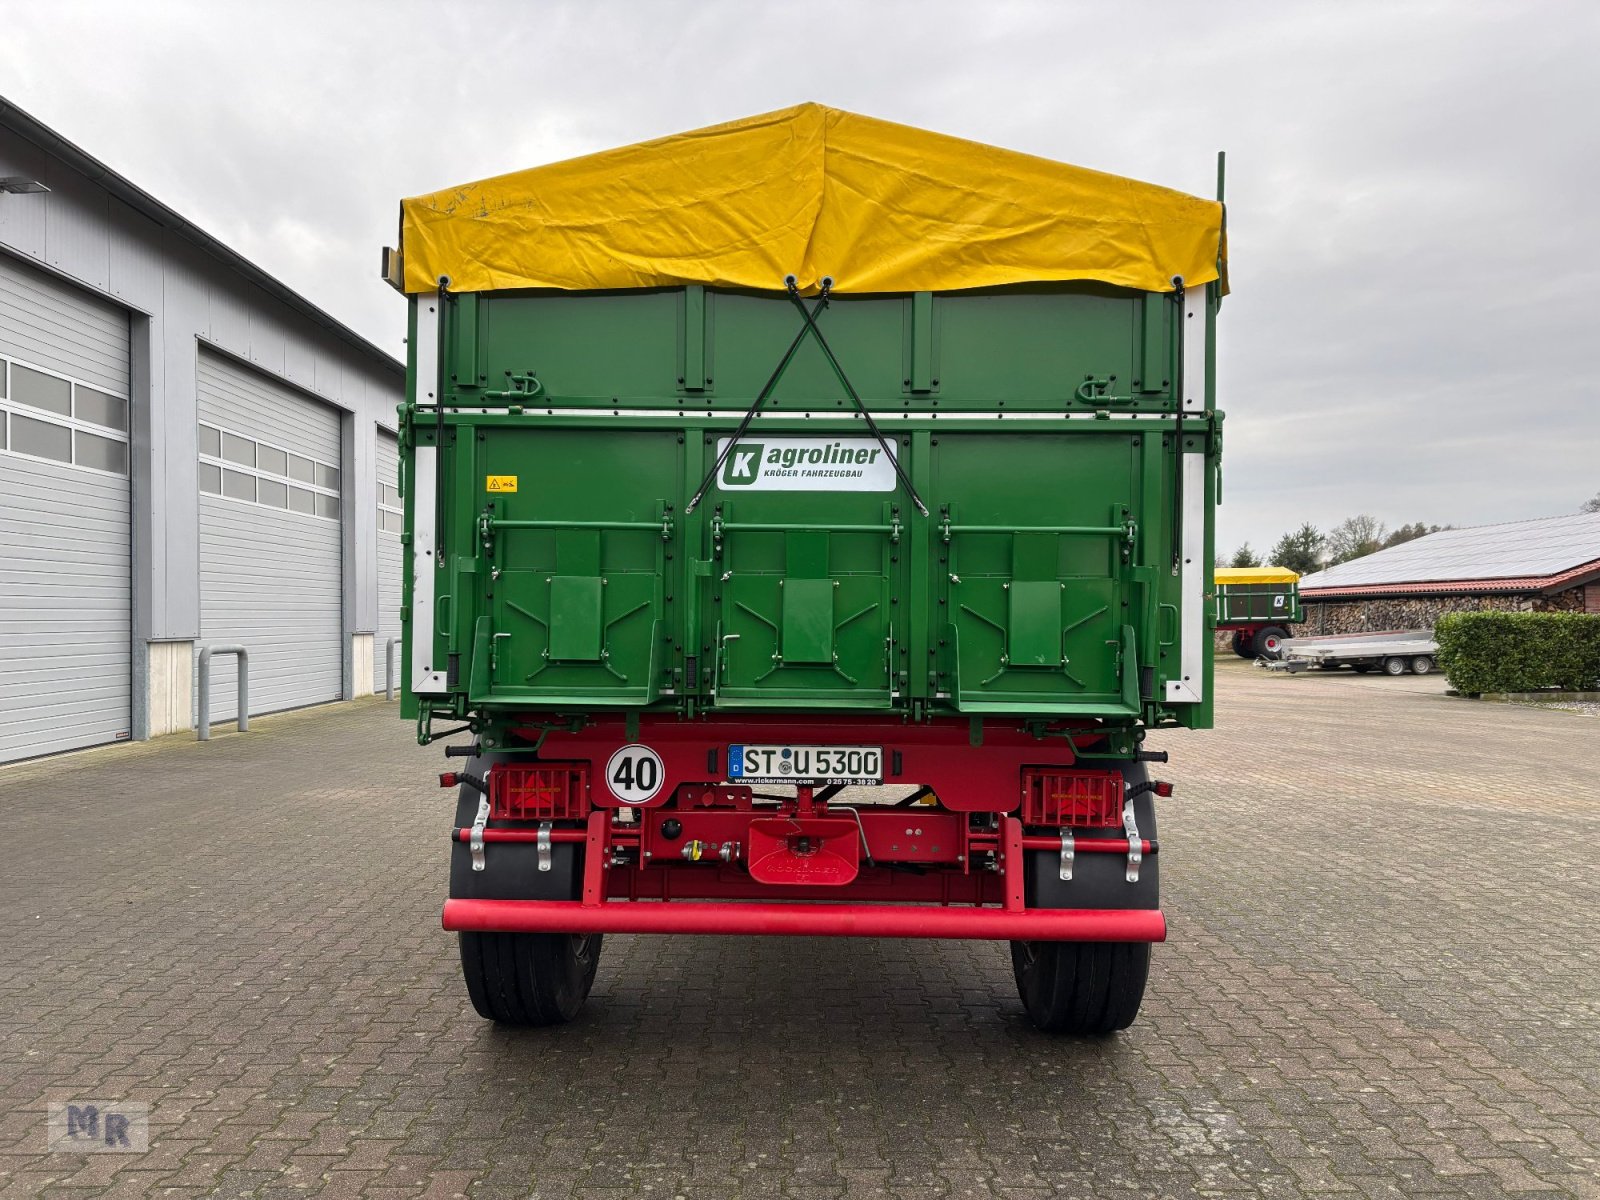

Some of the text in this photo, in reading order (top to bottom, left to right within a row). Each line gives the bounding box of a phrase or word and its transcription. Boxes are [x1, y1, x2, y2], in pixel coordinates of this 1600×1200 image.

[731, 452, 755, 477] K
[767, 442, 881, 469] agroliner
[764, 469, 863, 478] KRÖGER FAHRZEUGBAU
[613, 756, 657, 791] 40
[733, 764, 740, 772] D
[744, 749, 879, 775] ST U 5300
[734, 777, 815, 786] www.rickermann.com
